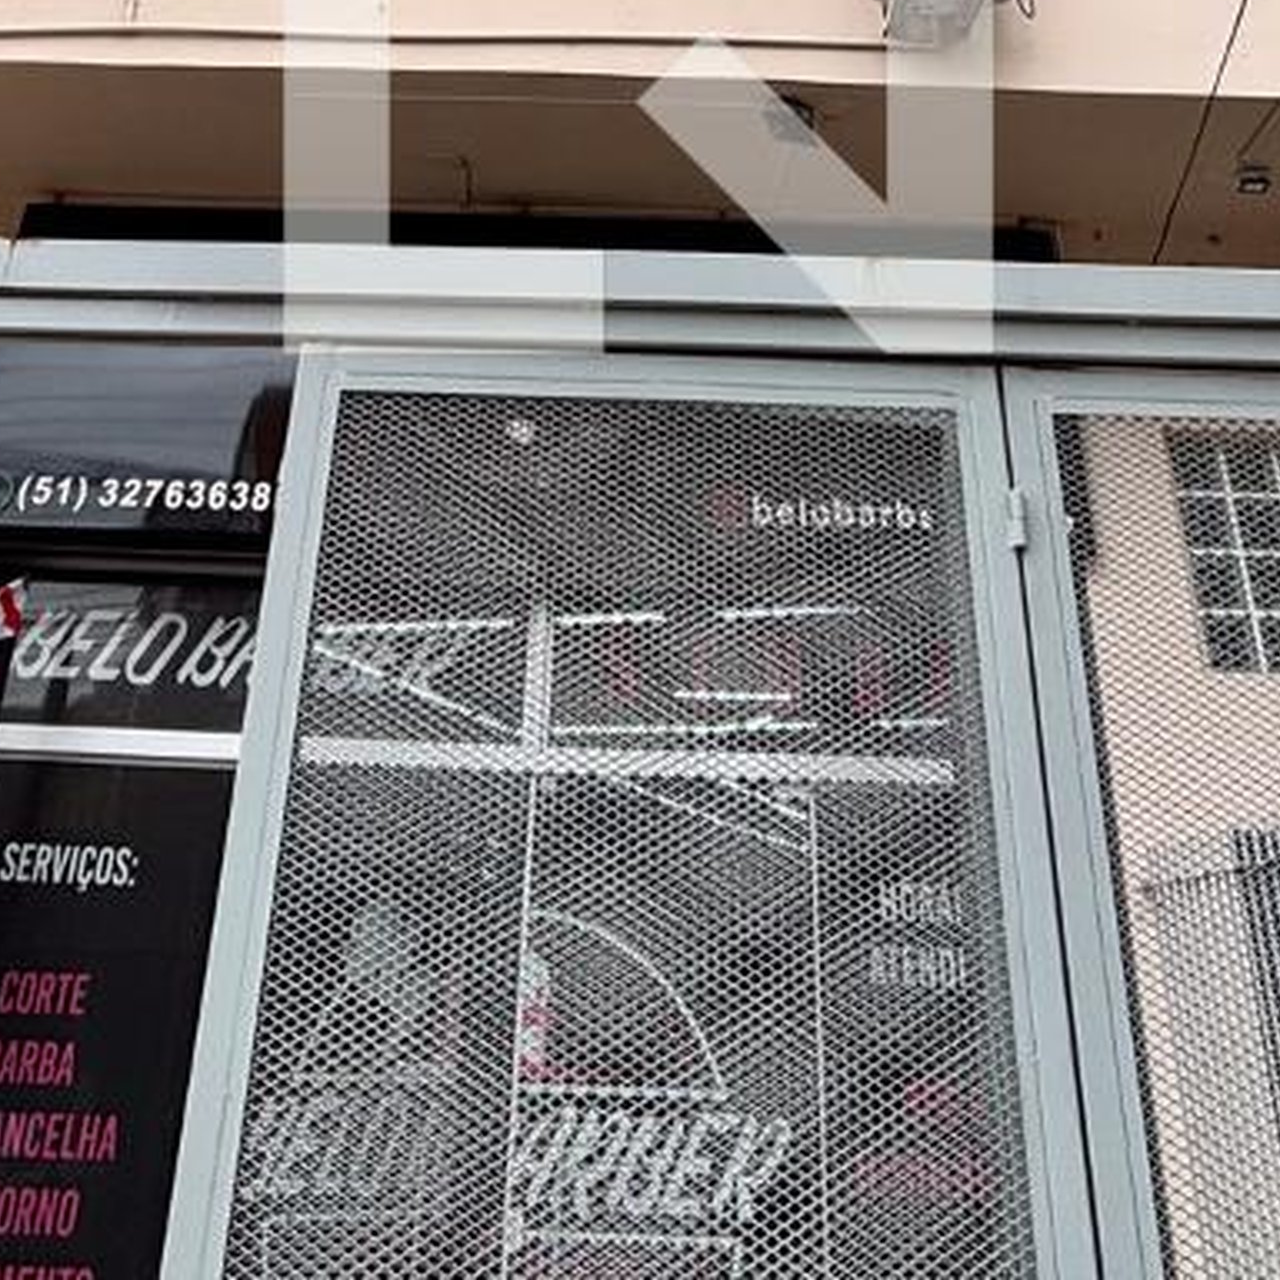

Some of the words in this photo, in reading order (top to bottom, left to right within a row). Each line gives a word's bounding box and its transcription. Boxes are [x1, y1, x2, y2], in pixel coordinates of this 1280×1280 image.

[18, 476, 87, 511] (51)
[97, 479, 272, 512] 32763638
[15, 609, 188, 685] BELO
[0, 841, 139, 893] SERVIÇOS:
